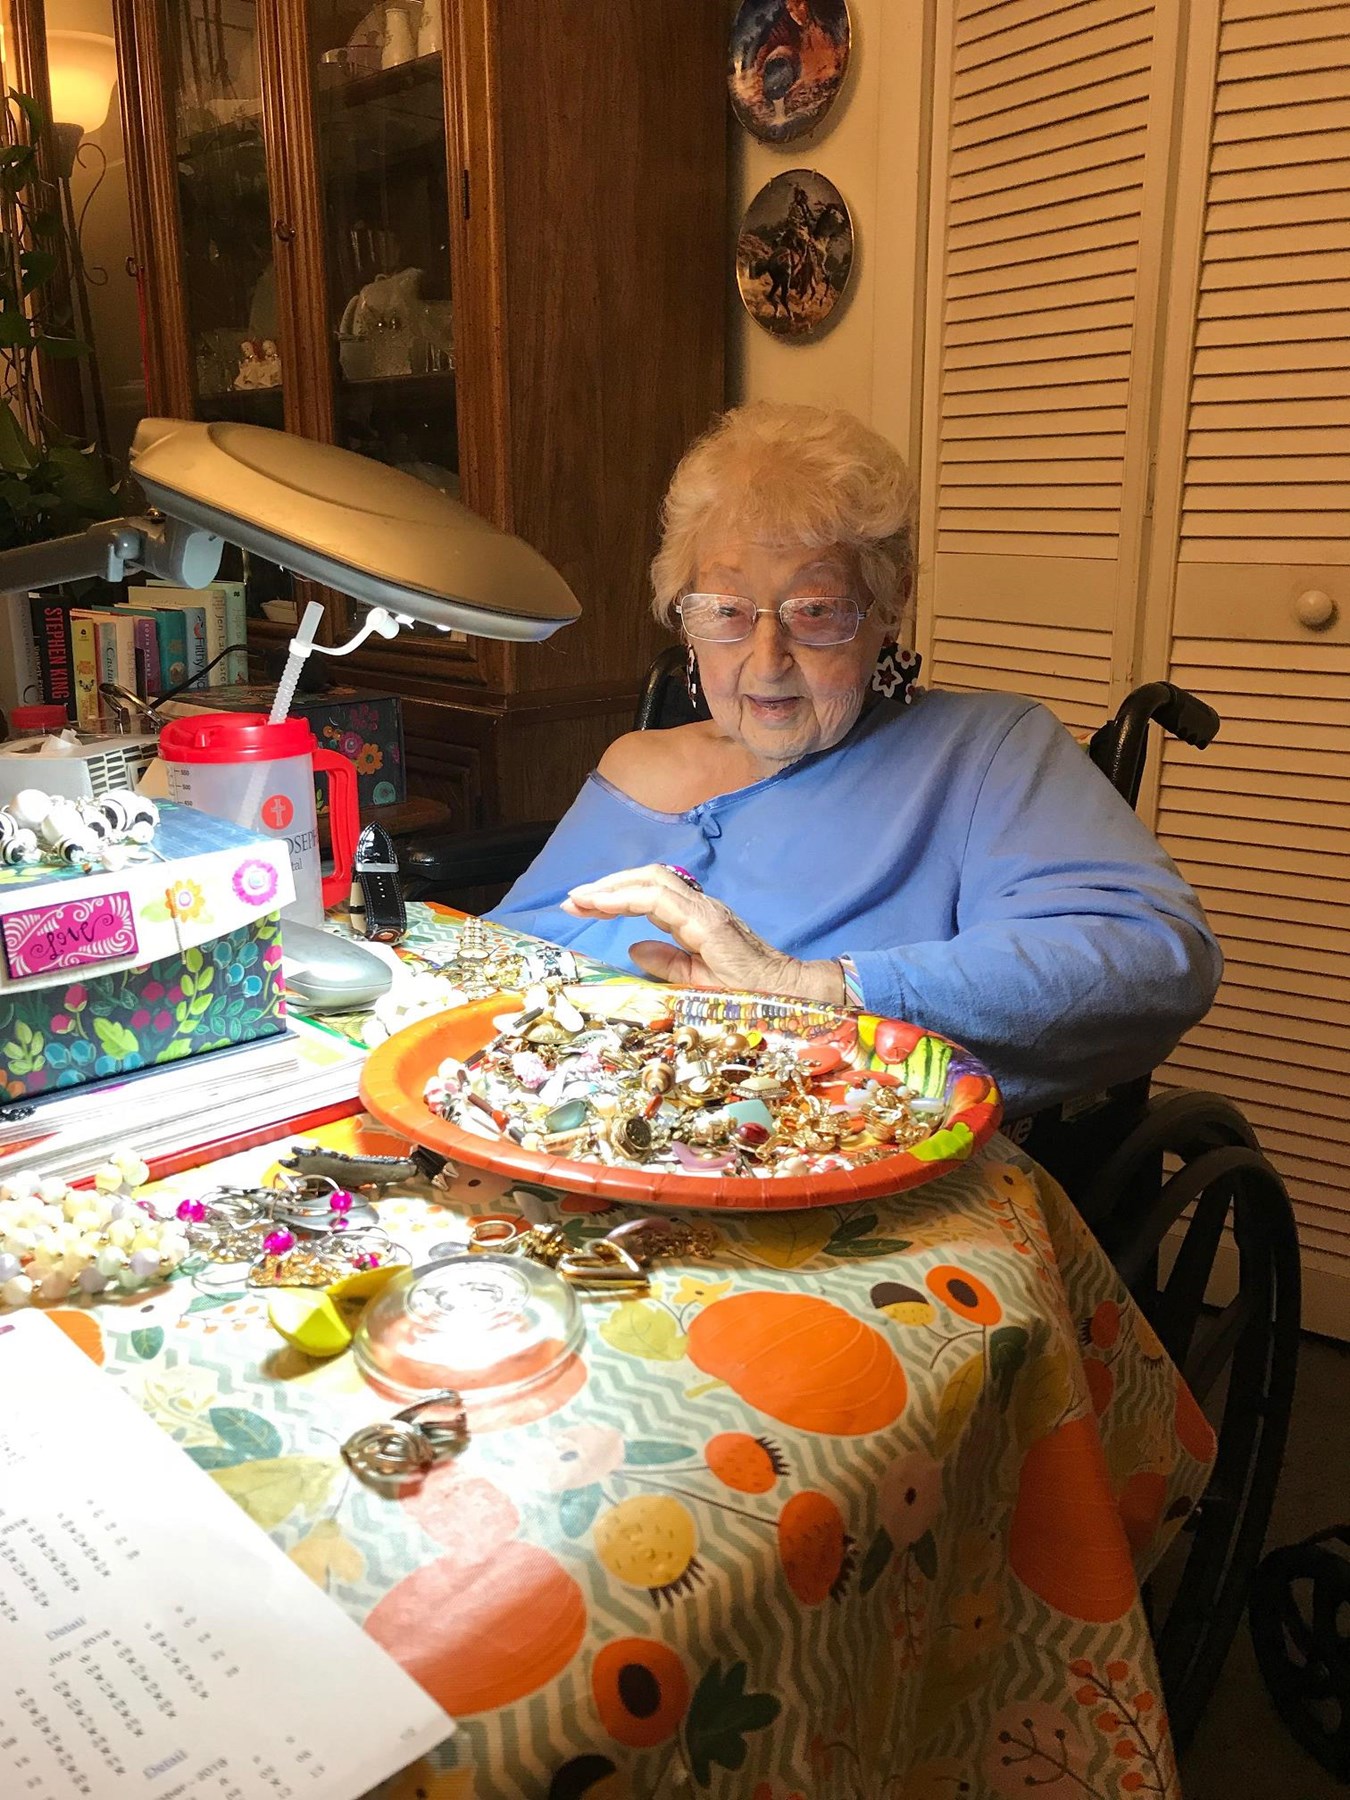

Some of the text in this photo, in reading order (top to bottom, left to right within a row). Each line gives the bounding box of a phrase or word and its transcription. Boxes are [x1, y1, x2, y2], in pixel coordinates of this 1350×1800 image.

[215, 615, 225, 631] Jen
[44, 607, 70, 699] STEPHEN KING
[193, 637, 206, 668] Filthy
[30, 913, 114, 960] Love
[142, 1749, 188, 1780] Detail
[197, 1757, 229, 1782] 2018
